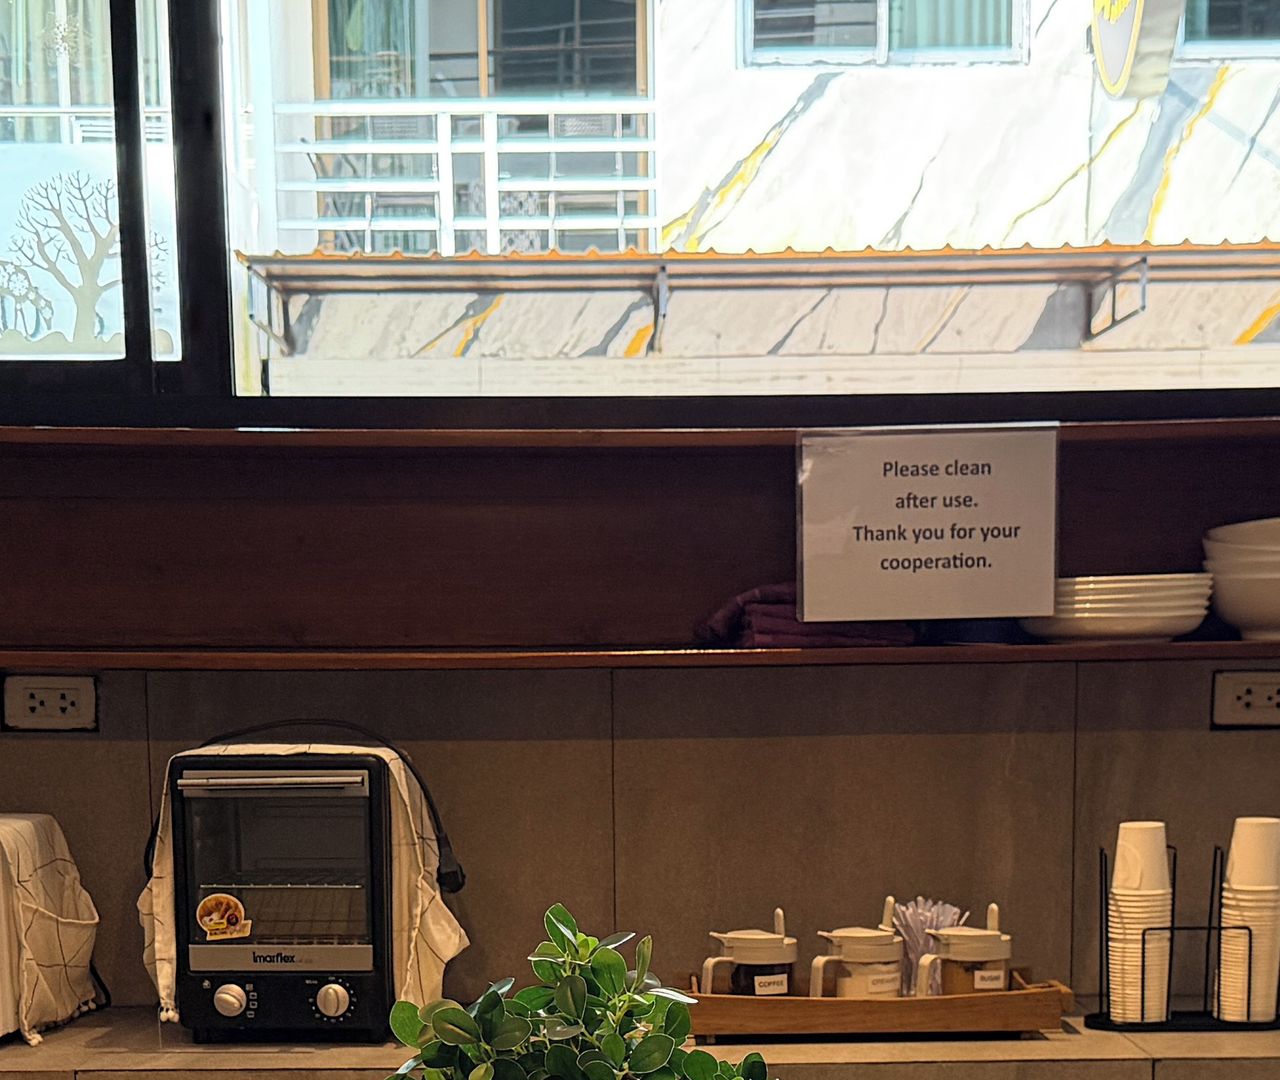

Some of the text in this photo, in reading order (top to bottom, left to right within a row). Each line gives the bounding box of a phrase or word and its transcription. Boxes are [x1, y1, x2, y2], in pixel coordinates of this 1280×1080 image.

[883, 459, 992, 477] Please clean
[895, 492, 978, 509] after use.
[853, 523, 1021, 544] Thank you for your
[880, 552, 992, 573] cooperation.
[252, 951, 296, 964] Imarflex
[758, 980, 785, 988] COFFEE
